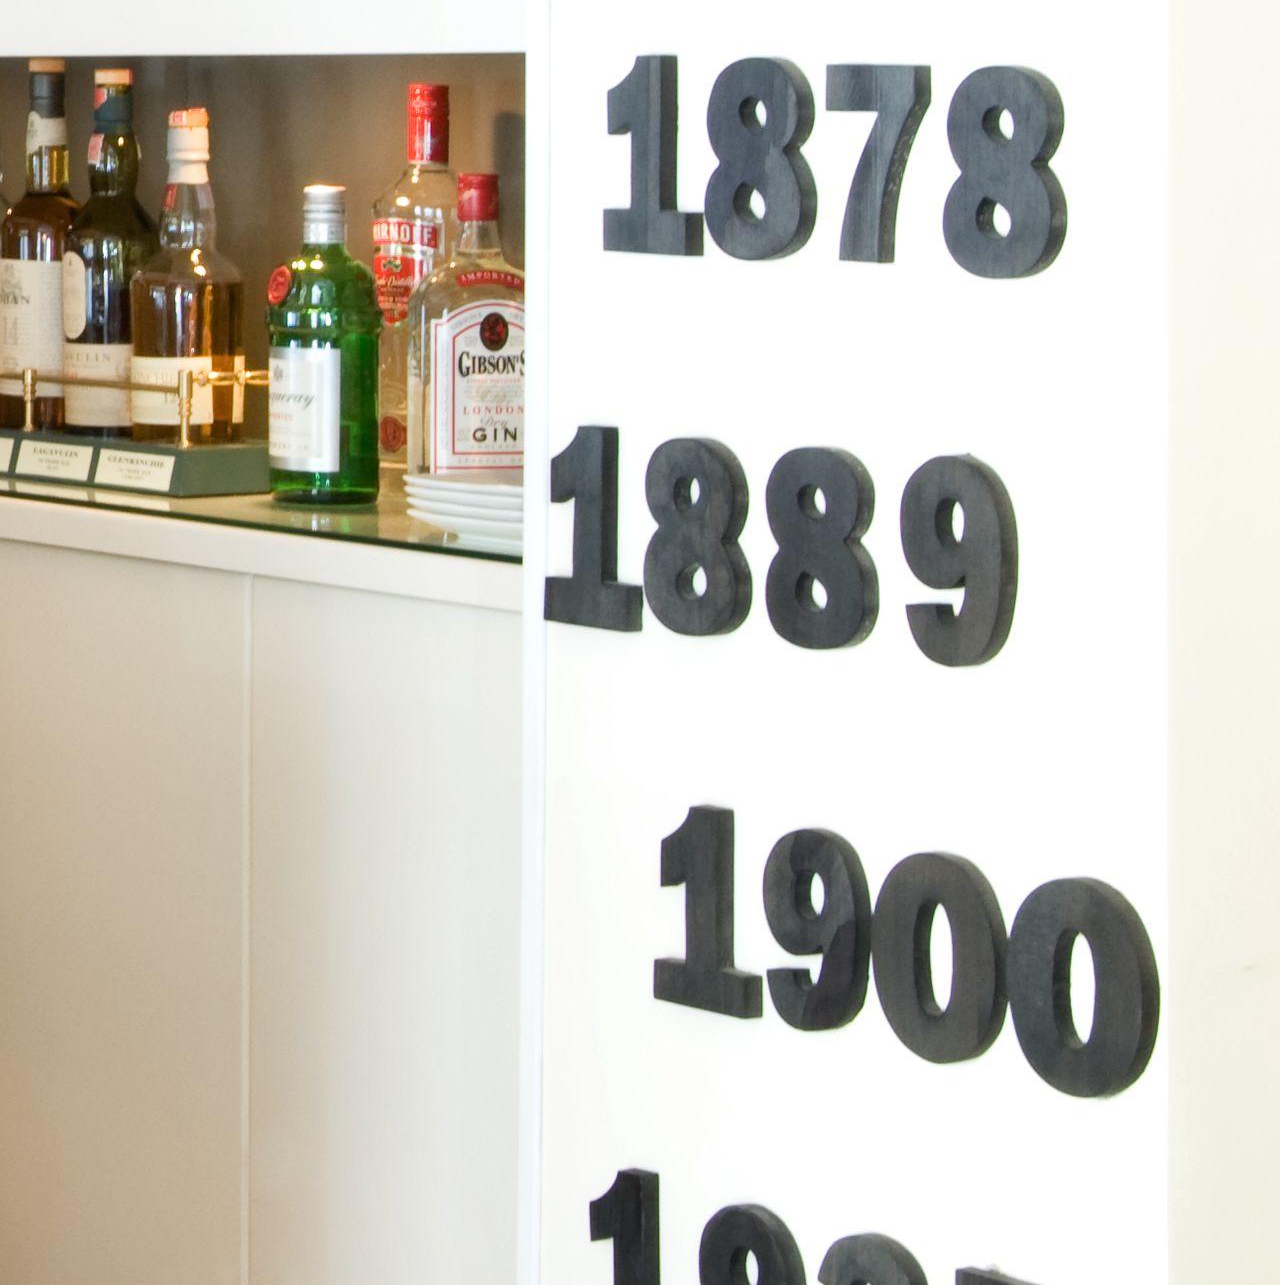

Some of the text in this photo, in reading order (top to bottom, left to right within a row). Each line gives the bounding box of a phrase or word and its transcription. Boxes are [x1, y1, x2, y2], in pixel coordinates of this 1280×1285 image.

[603, 55, 1068, 279] 1878
[462, 405, 525, 416] LONDON
[472, 427, 517, 443] GIN
[544, 425, 1019, 667] 1889
[653, 805, 1160, 1098] 1900
